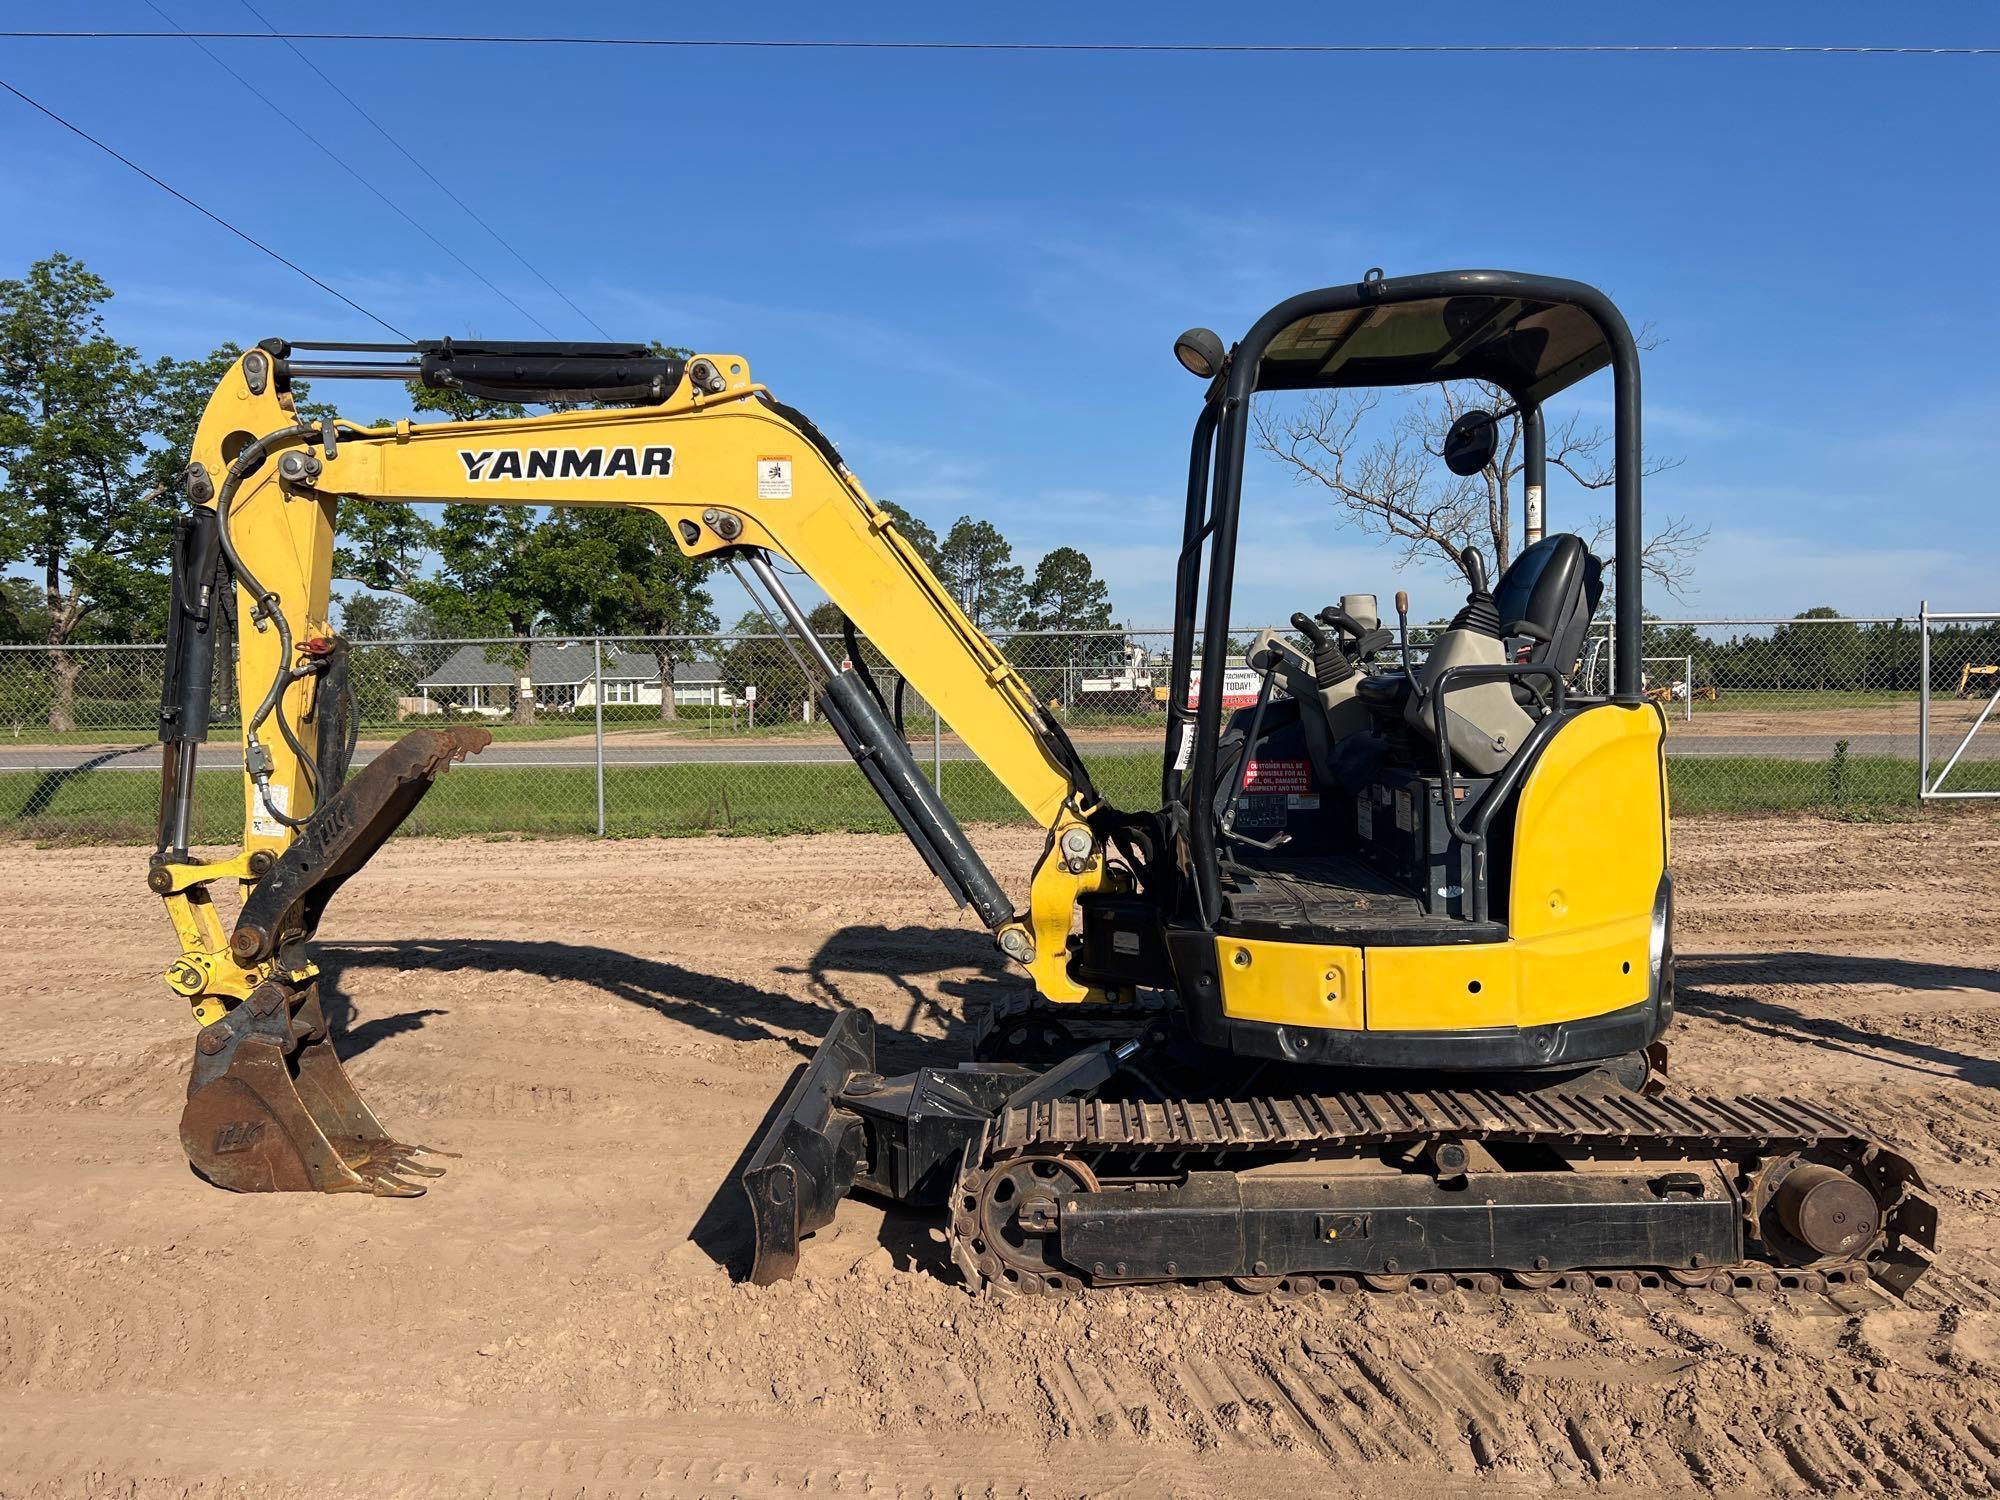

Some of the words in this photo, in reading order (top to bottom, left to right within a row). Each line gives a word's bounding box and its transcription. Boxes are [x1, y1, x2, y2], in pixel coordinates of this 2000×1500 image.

[461, 447, 673, 480] YANMAR
[1225, 672, 1258, 680] TACHMENTS
[1225, 681, 1251, 691] TODAY!
